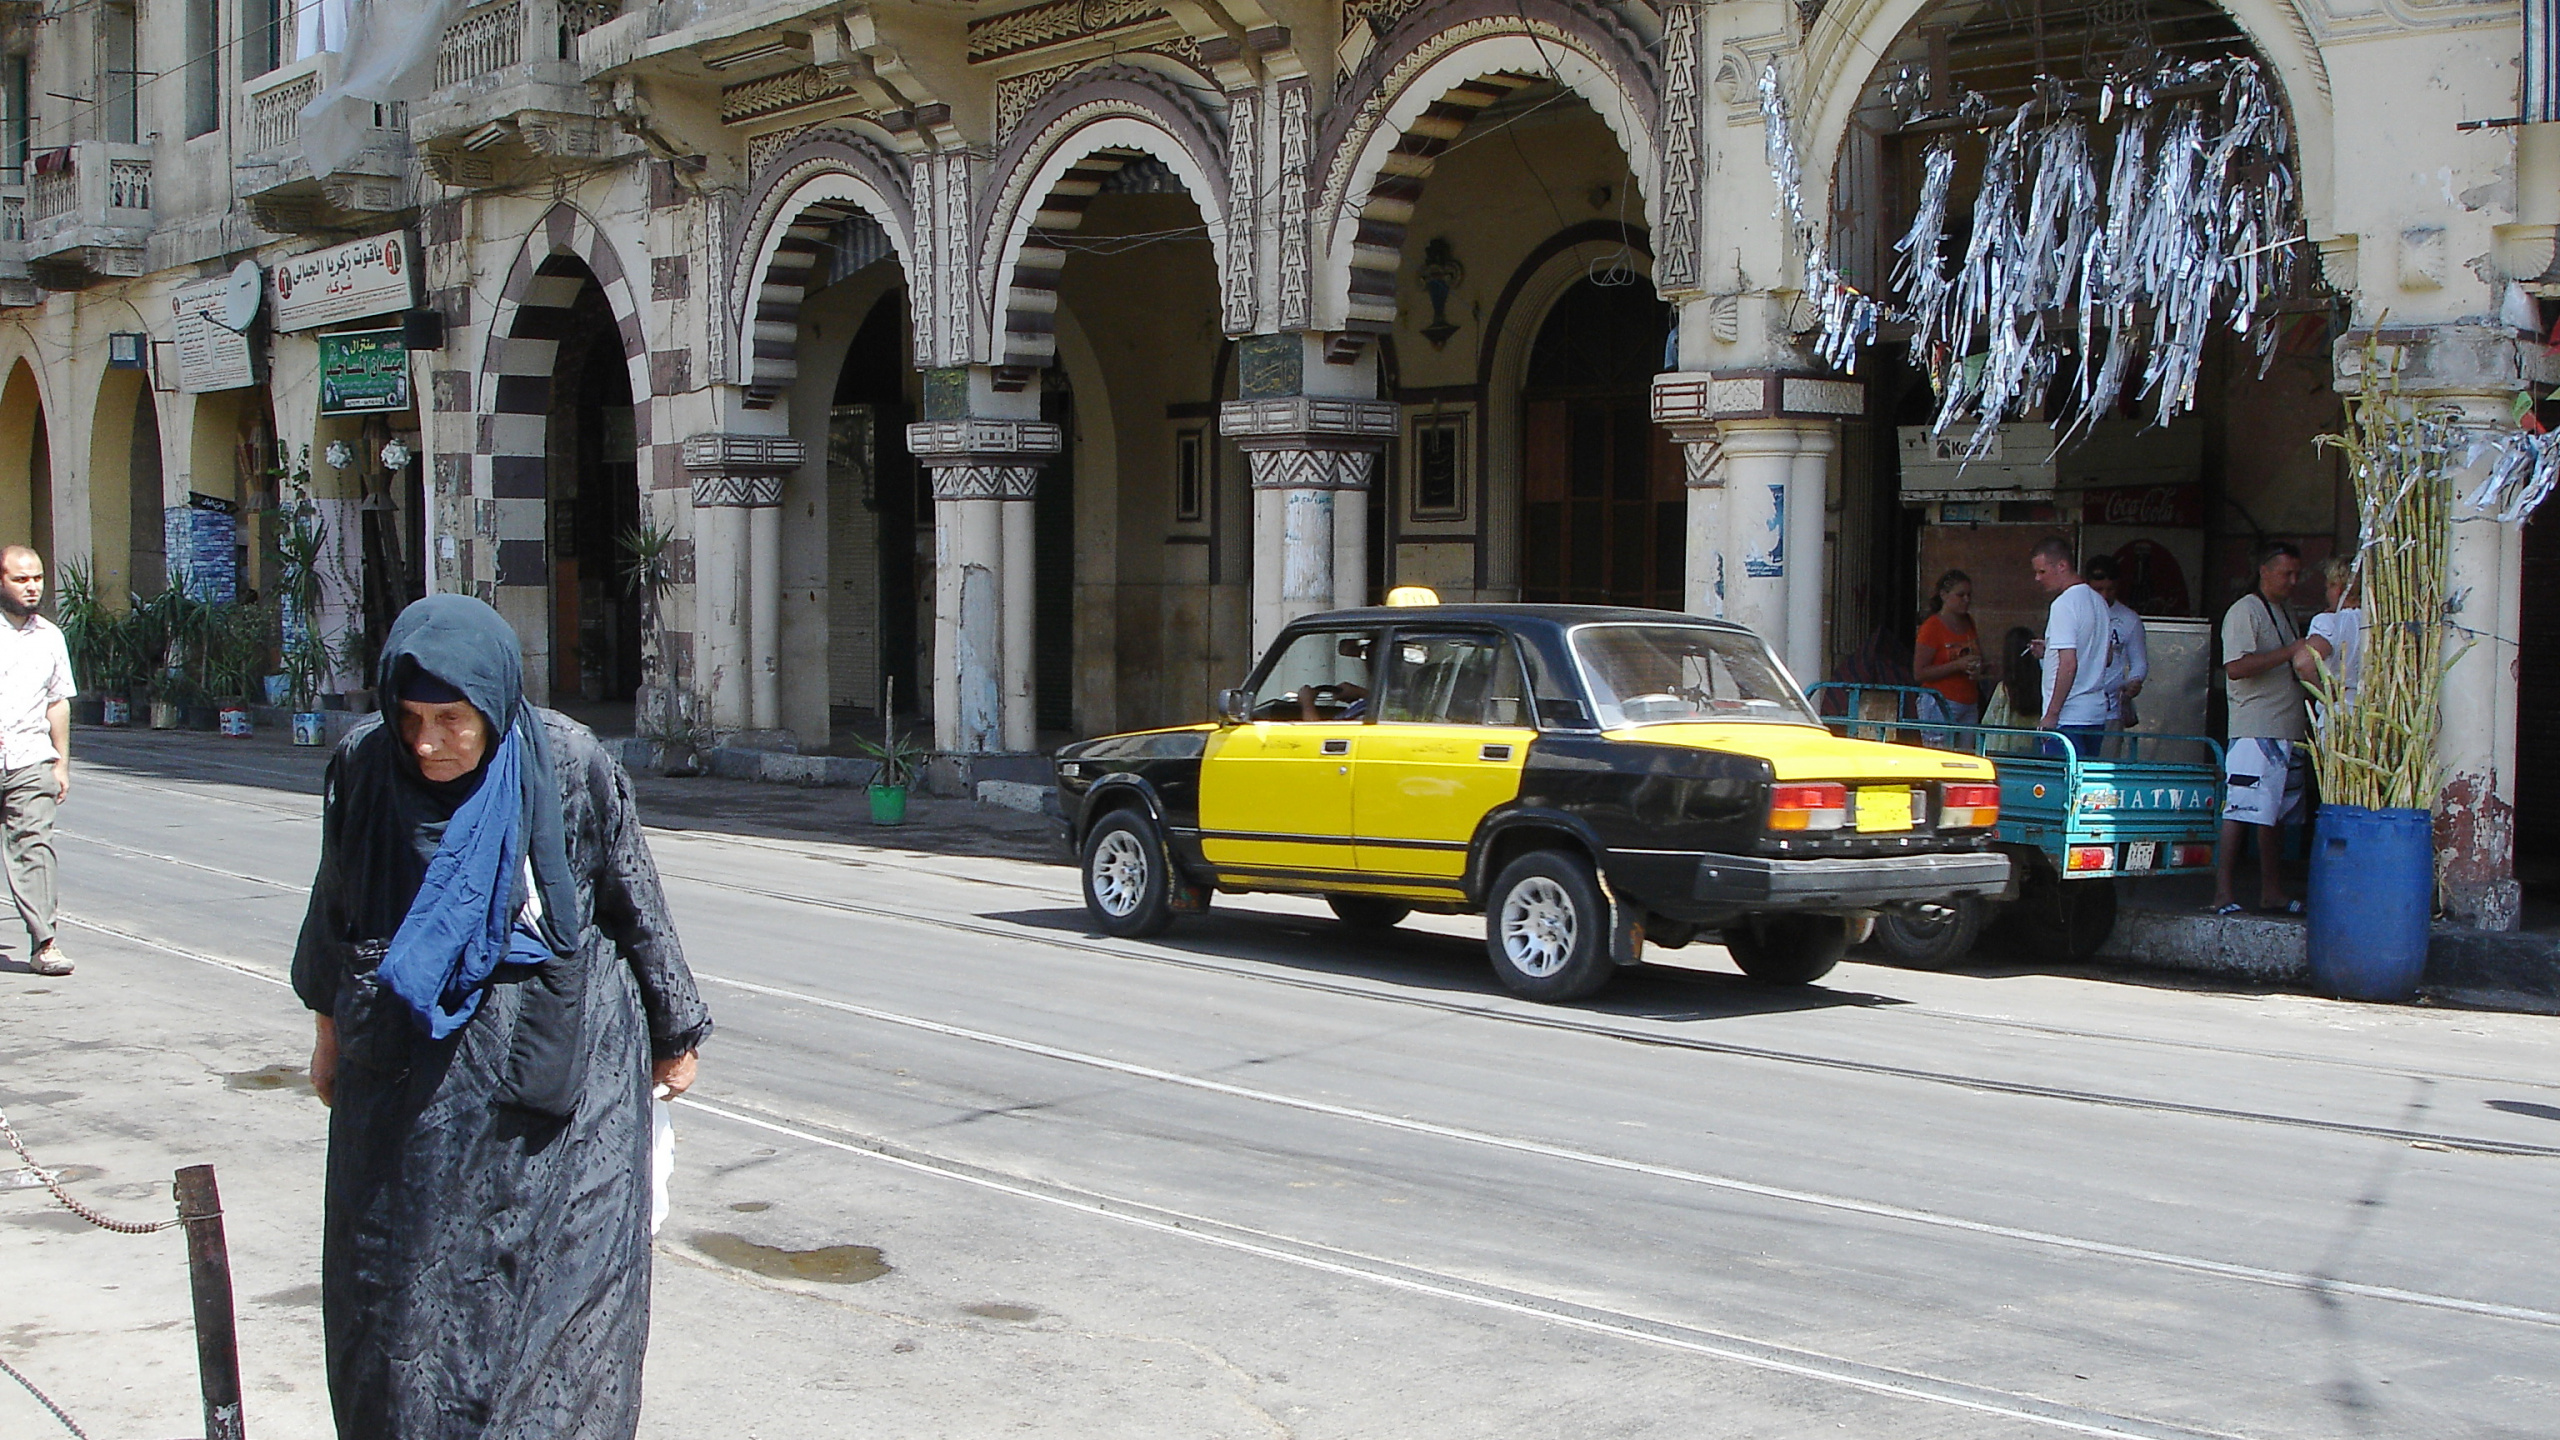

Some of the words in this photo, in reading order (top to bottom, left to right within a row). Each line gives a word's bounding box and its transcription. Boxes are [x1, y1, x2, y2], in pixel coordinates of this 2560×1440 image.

[326, 249, 352, 277] زكريا
[354, 242, 384, 269] ياقوت
[349, 338, 376, 355] سنترال
[326, 354, 368, 379] المساجد
[370, 354, 403, 378] ميدان
[1951, 440, 1995, 456] Koak
